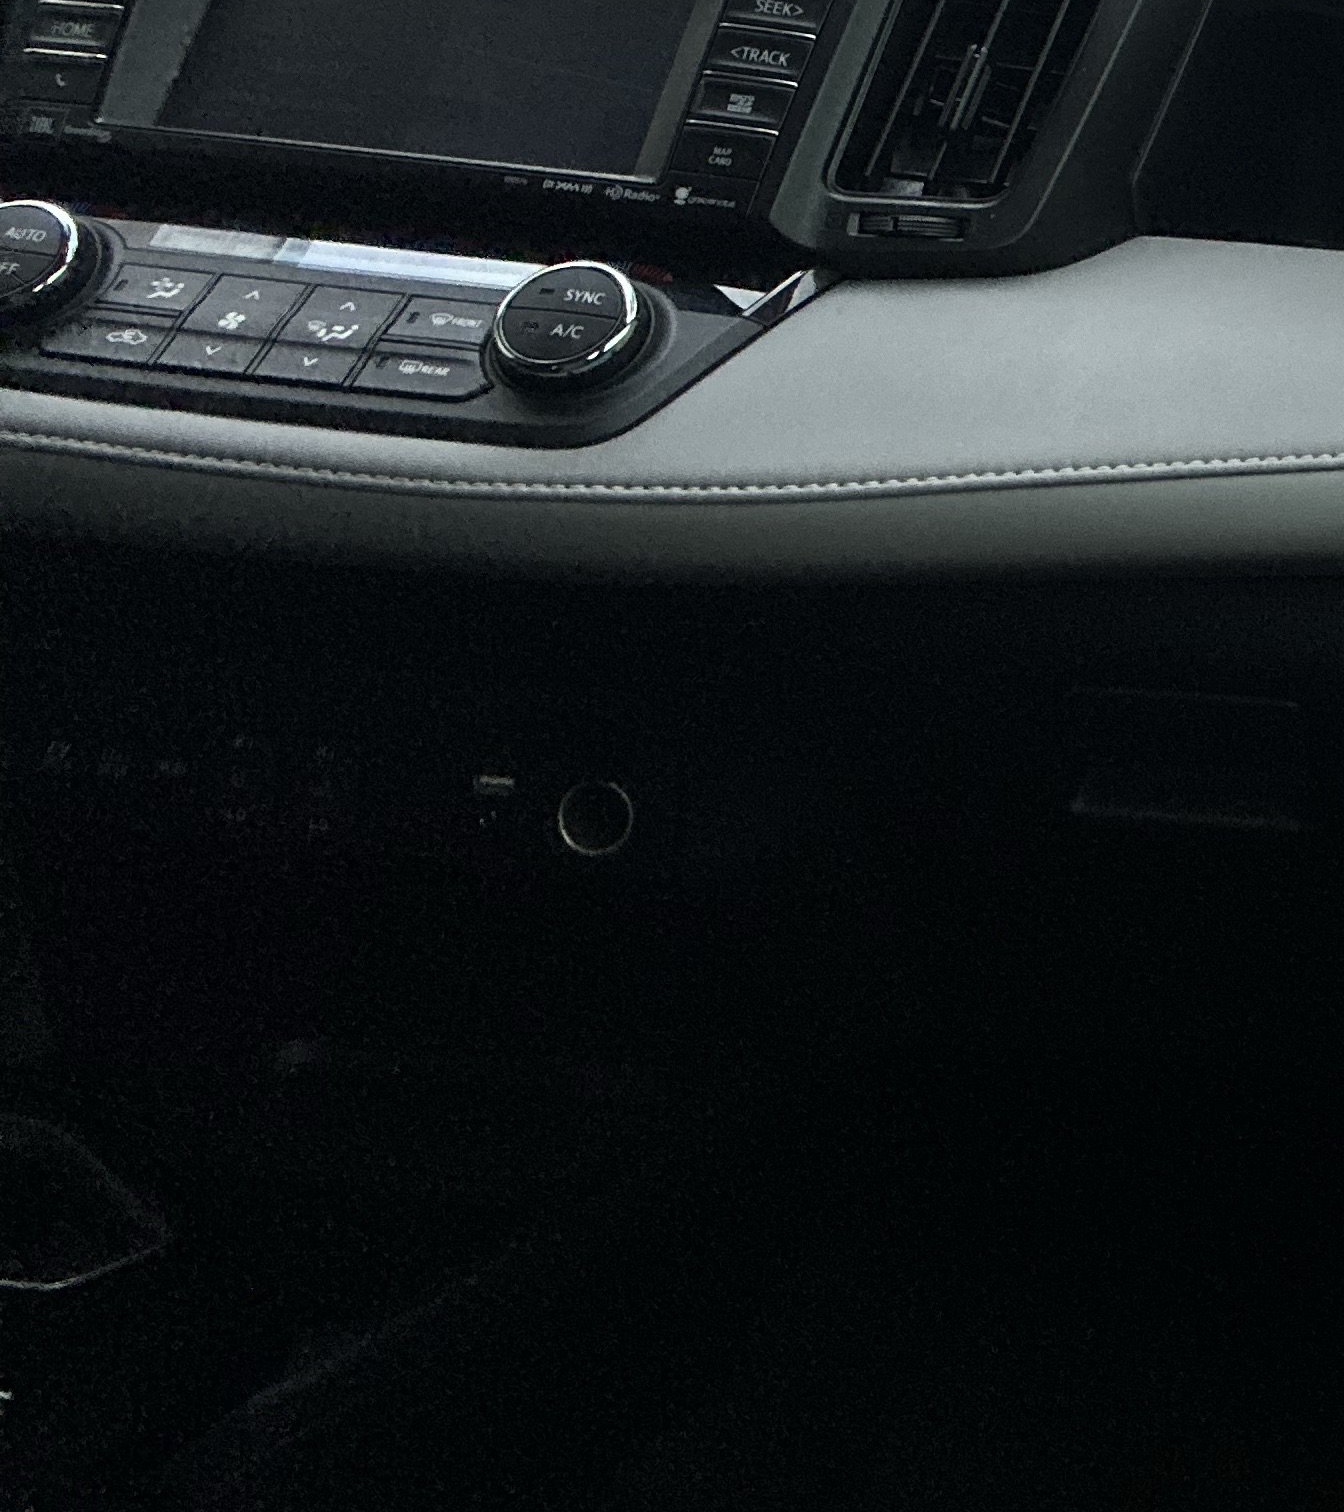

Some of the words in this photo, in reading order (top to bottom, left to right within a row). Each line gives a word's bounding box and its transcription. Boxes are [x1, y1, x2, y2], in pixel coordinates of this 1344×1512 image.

[51, 22, 96, 38] HOME
[4, 226, 48, 242] AUTO
[0, 261, 21, 276] FF
[562, 289, 607, 306] SYNC
[549, 322, 585, 339] A/C
